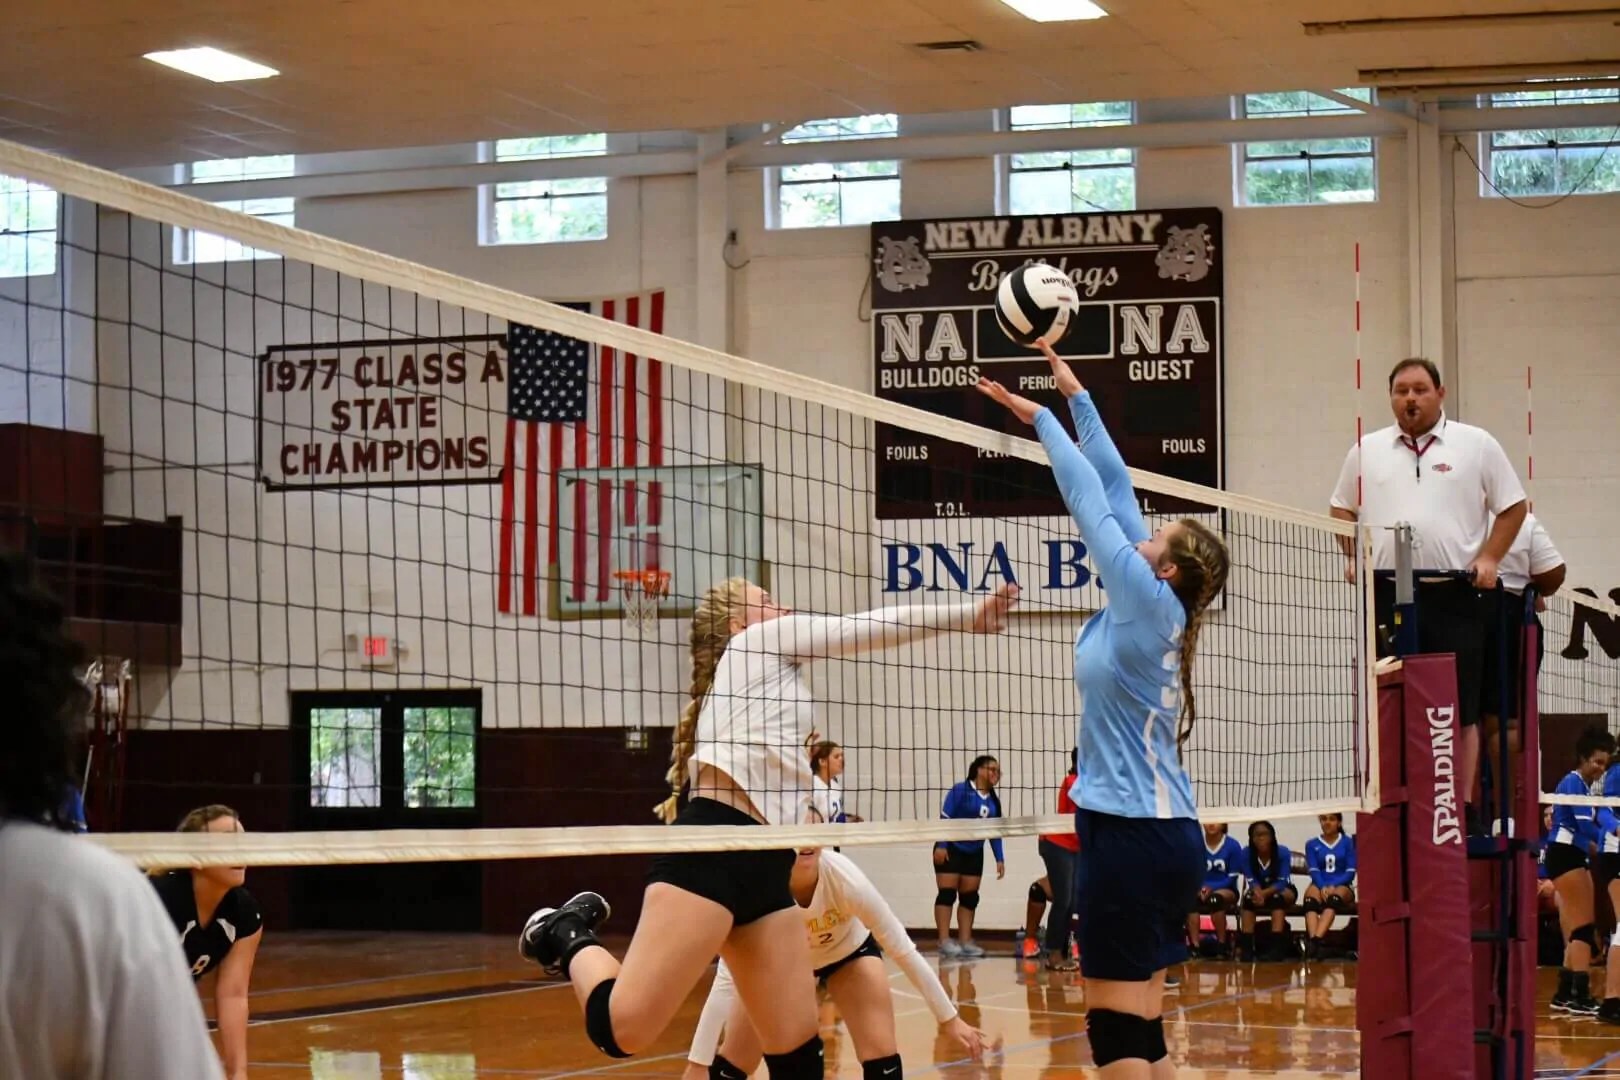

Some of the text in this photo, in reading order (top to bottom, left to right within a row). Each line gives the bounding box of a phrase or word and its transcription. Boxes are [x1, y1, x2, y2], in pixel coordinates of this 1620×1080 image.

[924, 213, 1163, 250] NEW ALBANY
[881, 313, 967, 363] NA
[1120, 304, 1210, 355] NA
[266, 350, 504, 392] 1977 CLASS A
[881, 365, 980, 388] BULLDOGS
[1019, 375, 1057, 390] PERIO
[1128, 359, 1194, 381] GUEST
[331, 396, 437, 431] STATE
[280, 436, 488, 476] CHAMPIONS
[886, 445, 928, 460] FOULS
[1162, 438, 1206, 454] FOULS
[935, 502, 970, 517] T.O.L.
[881, 540, 1105, 593] BNA B
[1426, 703, 1463, 845] SPALDING
[1325, 854, 1336, 873] 8
